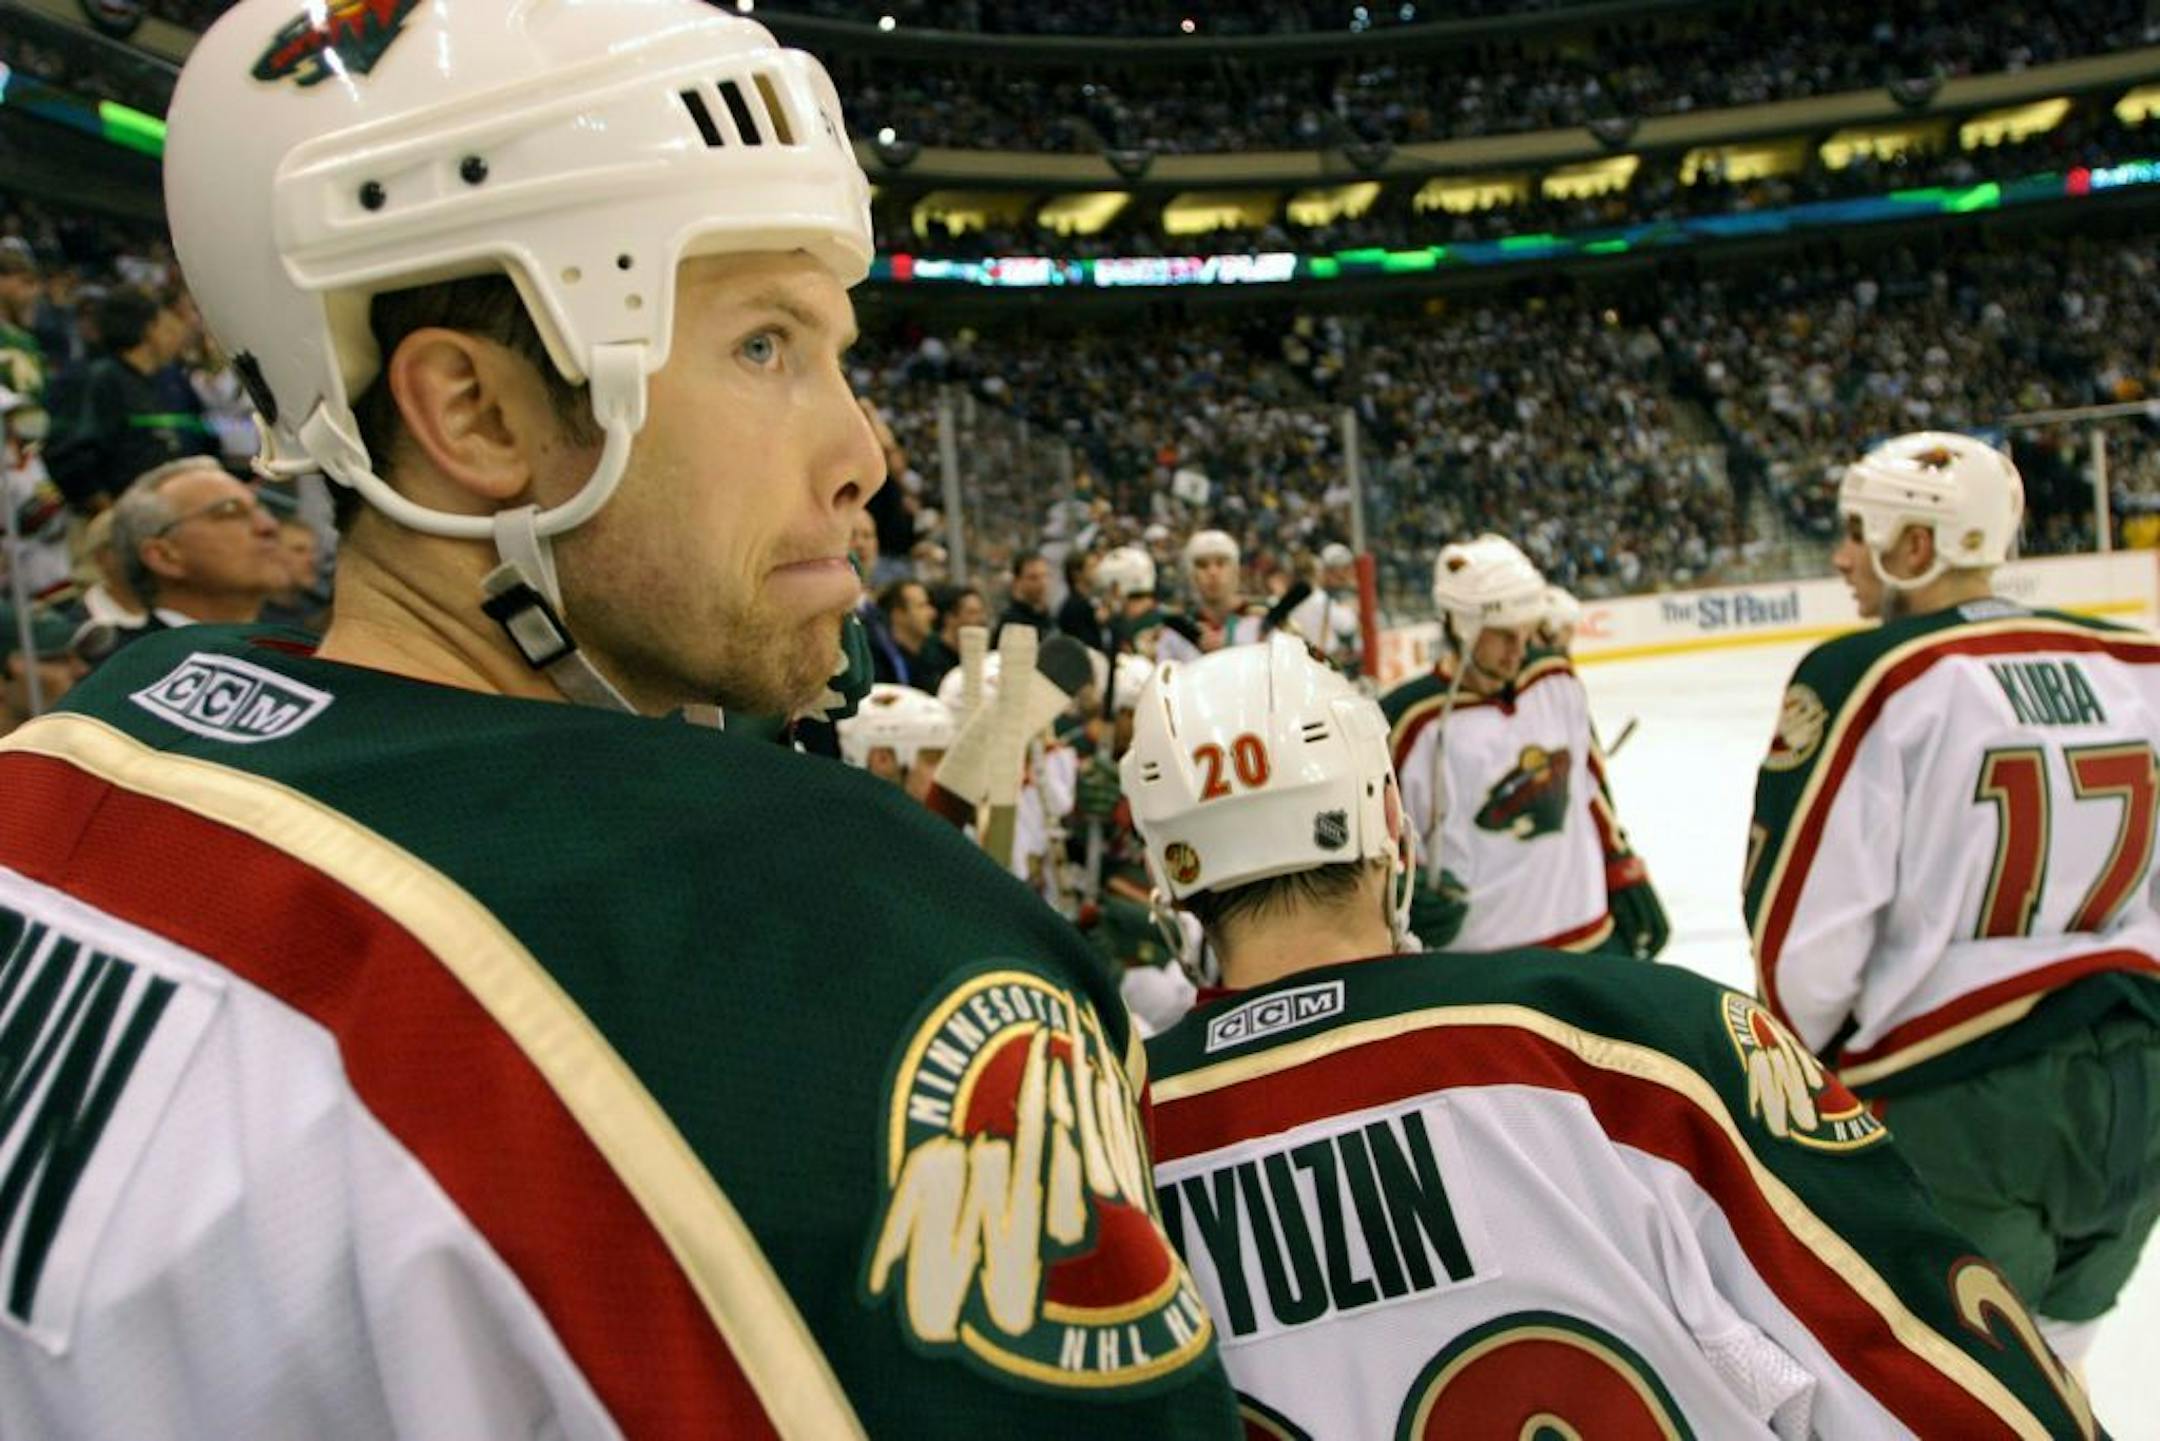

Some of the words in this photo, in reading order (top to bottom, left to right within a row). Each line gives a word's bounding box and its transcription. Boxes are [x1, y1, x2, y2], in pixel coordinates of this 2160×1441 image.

[160, 667, 306, 736] CCM
[1988, 662, 2106, 725] KUBA
[1194, 732, 1270, 802] 20
[1974, 741, 2158, 940] 17
[1216, 989, 1335, 1041] CCM
[909, 986, 1067, 1127] MINNESOTA
[1059, 1323, 1151, 1373] NHL
